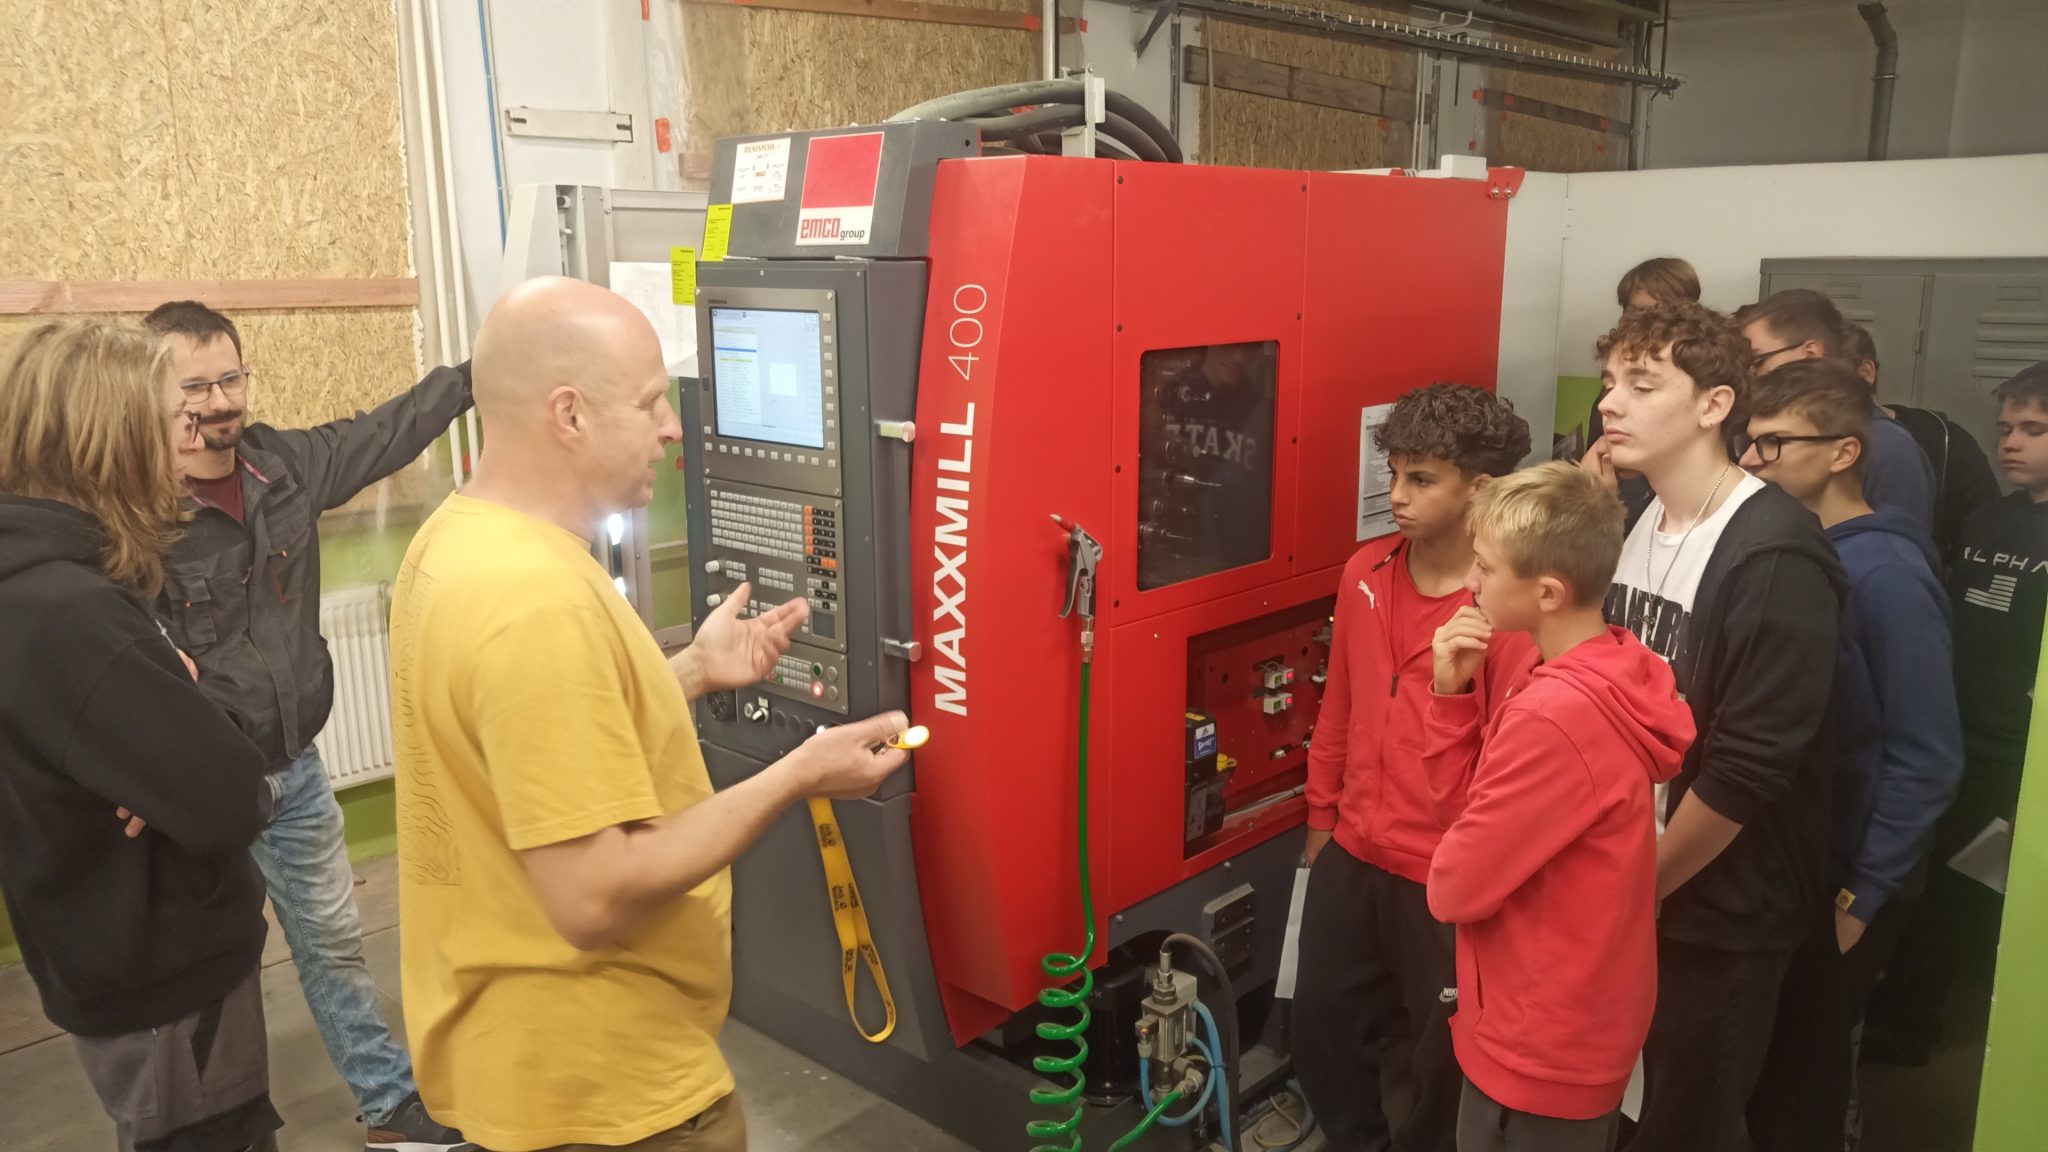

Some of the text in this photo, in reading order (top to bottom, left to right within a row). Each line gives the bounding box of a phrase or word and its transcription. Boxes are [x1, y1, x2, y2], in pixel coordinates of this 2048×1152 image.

[840, 230, 865, 241] group
[933, 283, 988, 717] MAXXMILL 400
